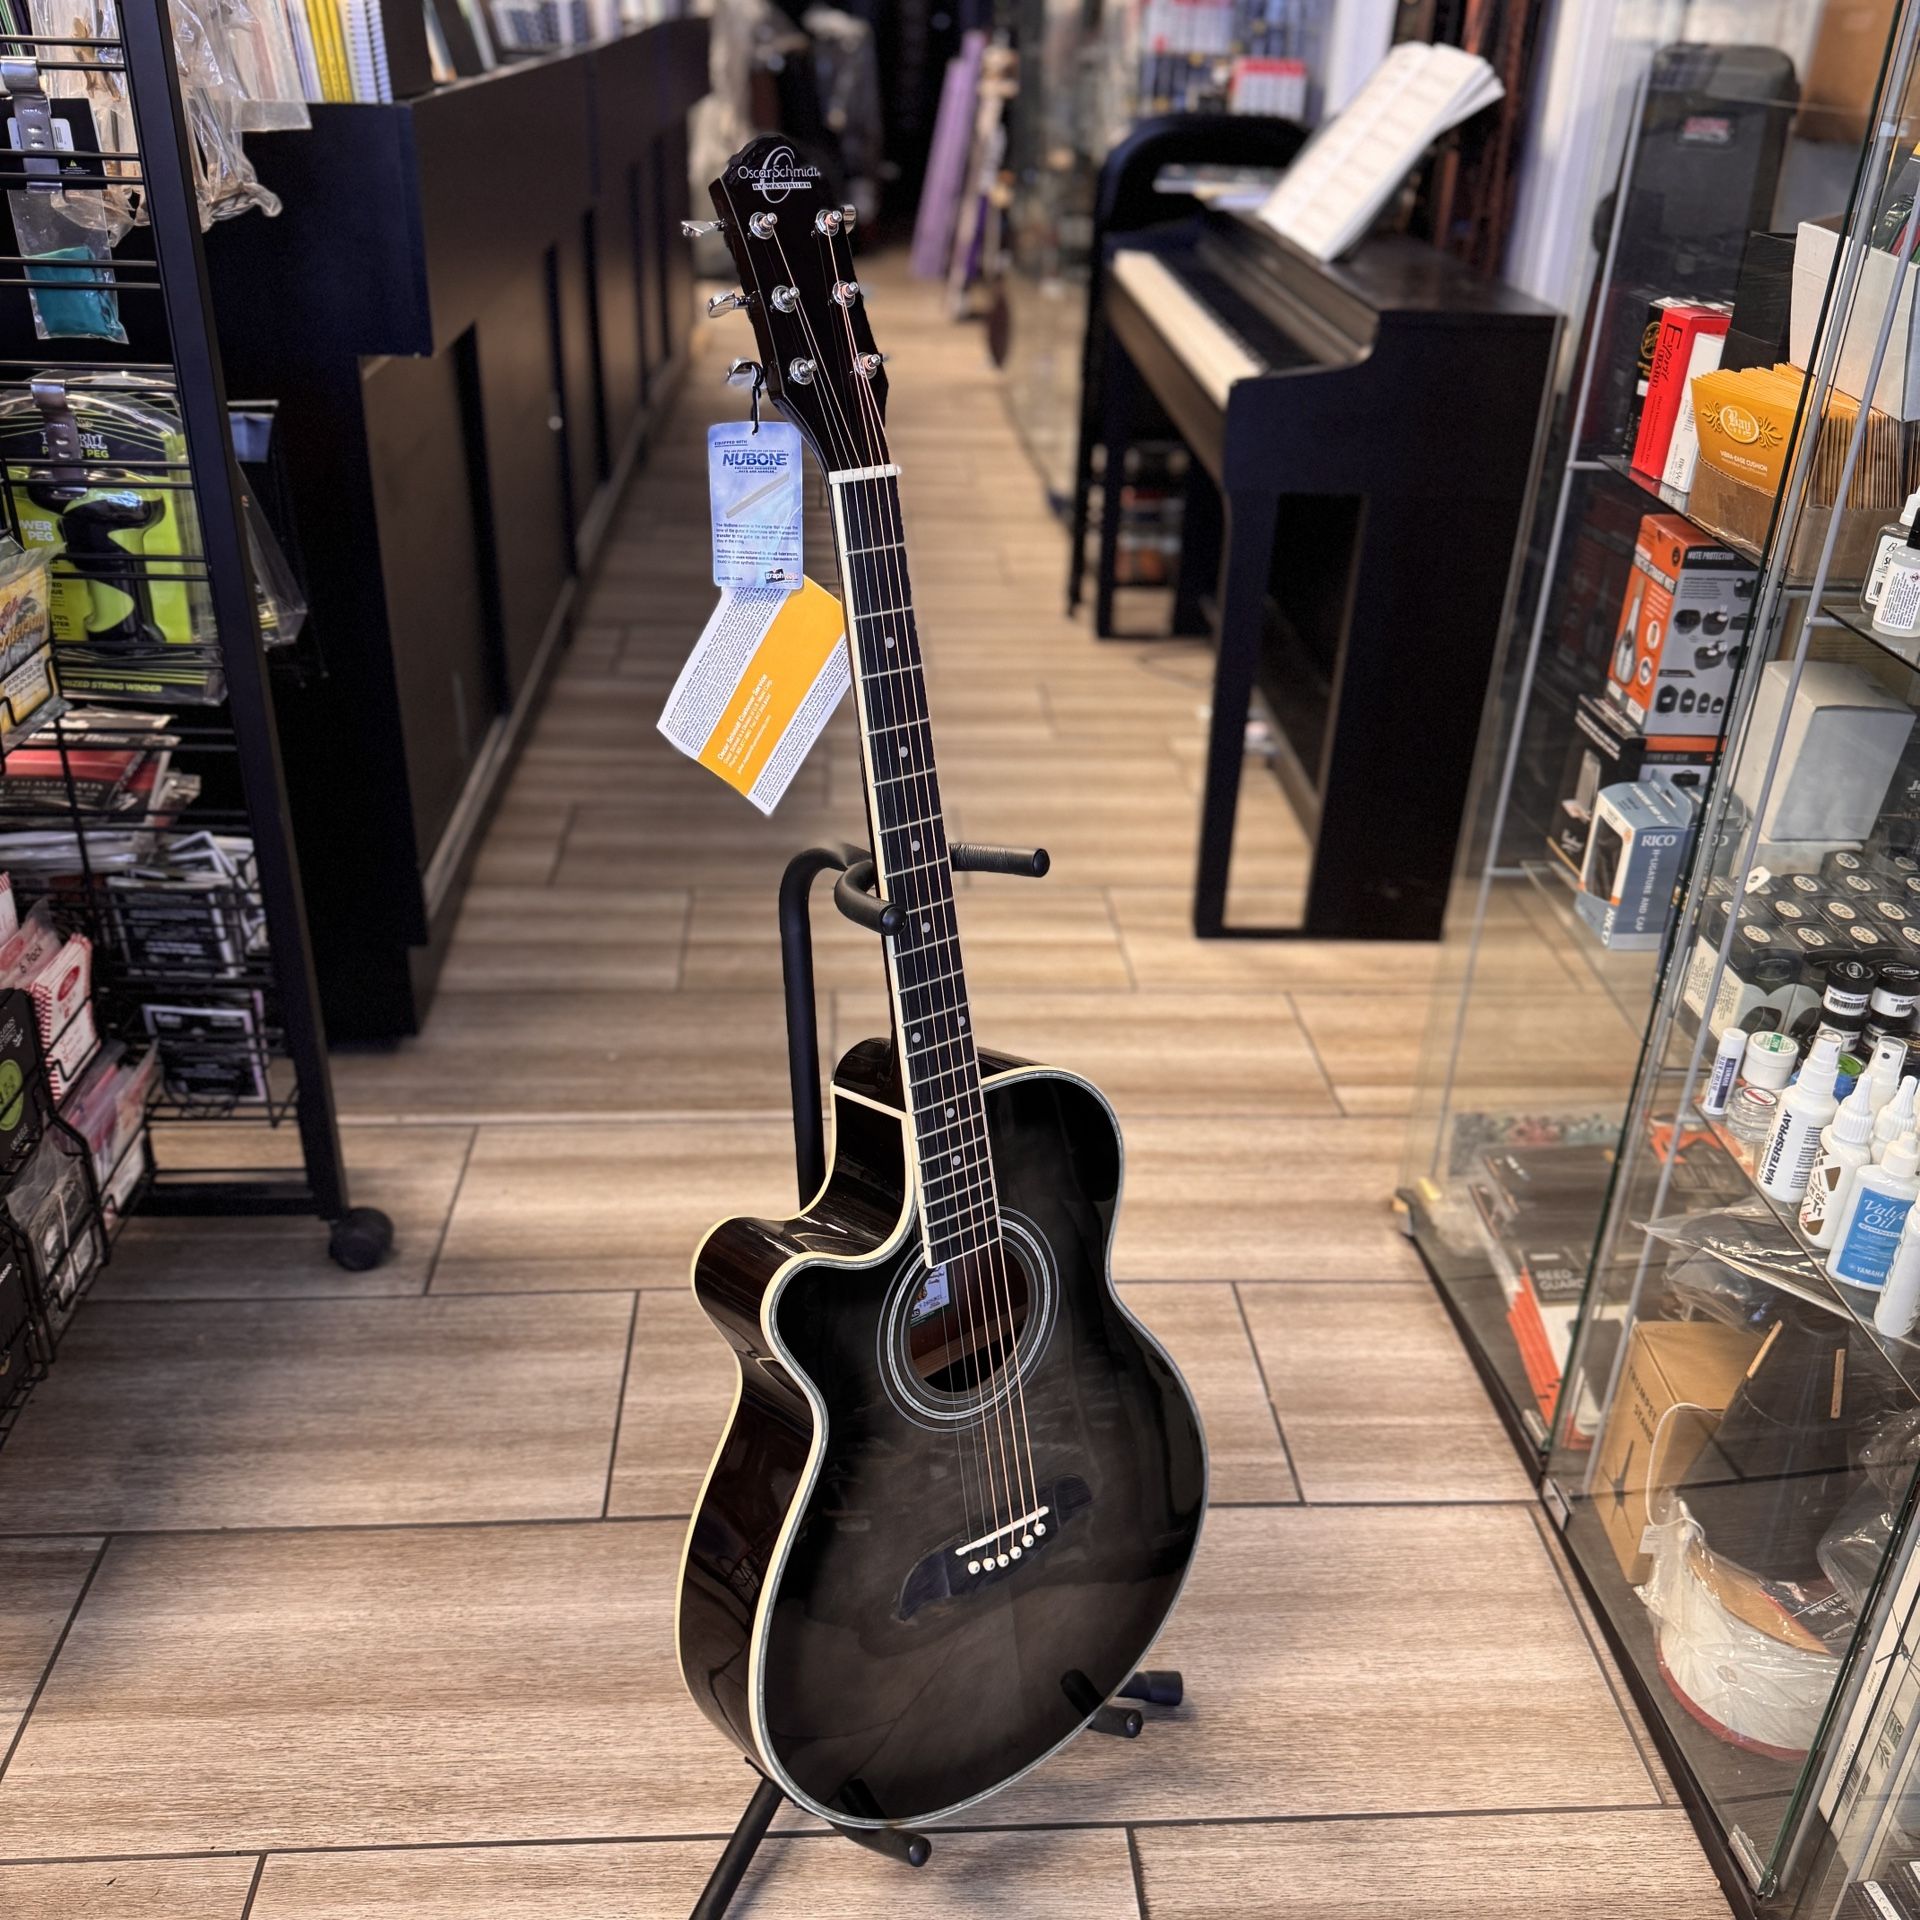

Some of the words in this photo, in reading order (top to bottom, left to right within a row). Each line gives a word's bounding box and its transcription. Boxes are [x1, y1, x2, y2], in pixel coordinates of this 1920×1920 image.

[27, 531, 54, 541] PEG
[125, 684, 163, 692] WINDER
[1641, 834, 1677, 847] RICO
[1638, 898, 1650, 915] AND
[1634, 915, 1647, 933] CAP
[1763, 1109, 1793, 1186] WATERSPRAY
[1815, 1193, 1826, 1206] OIL
[1864, 1213, 1896, 1229] Oil
[1856, 1266, 1884, 1279] YAMAHA
[1633, 1404, 1655, 1445] STAND
